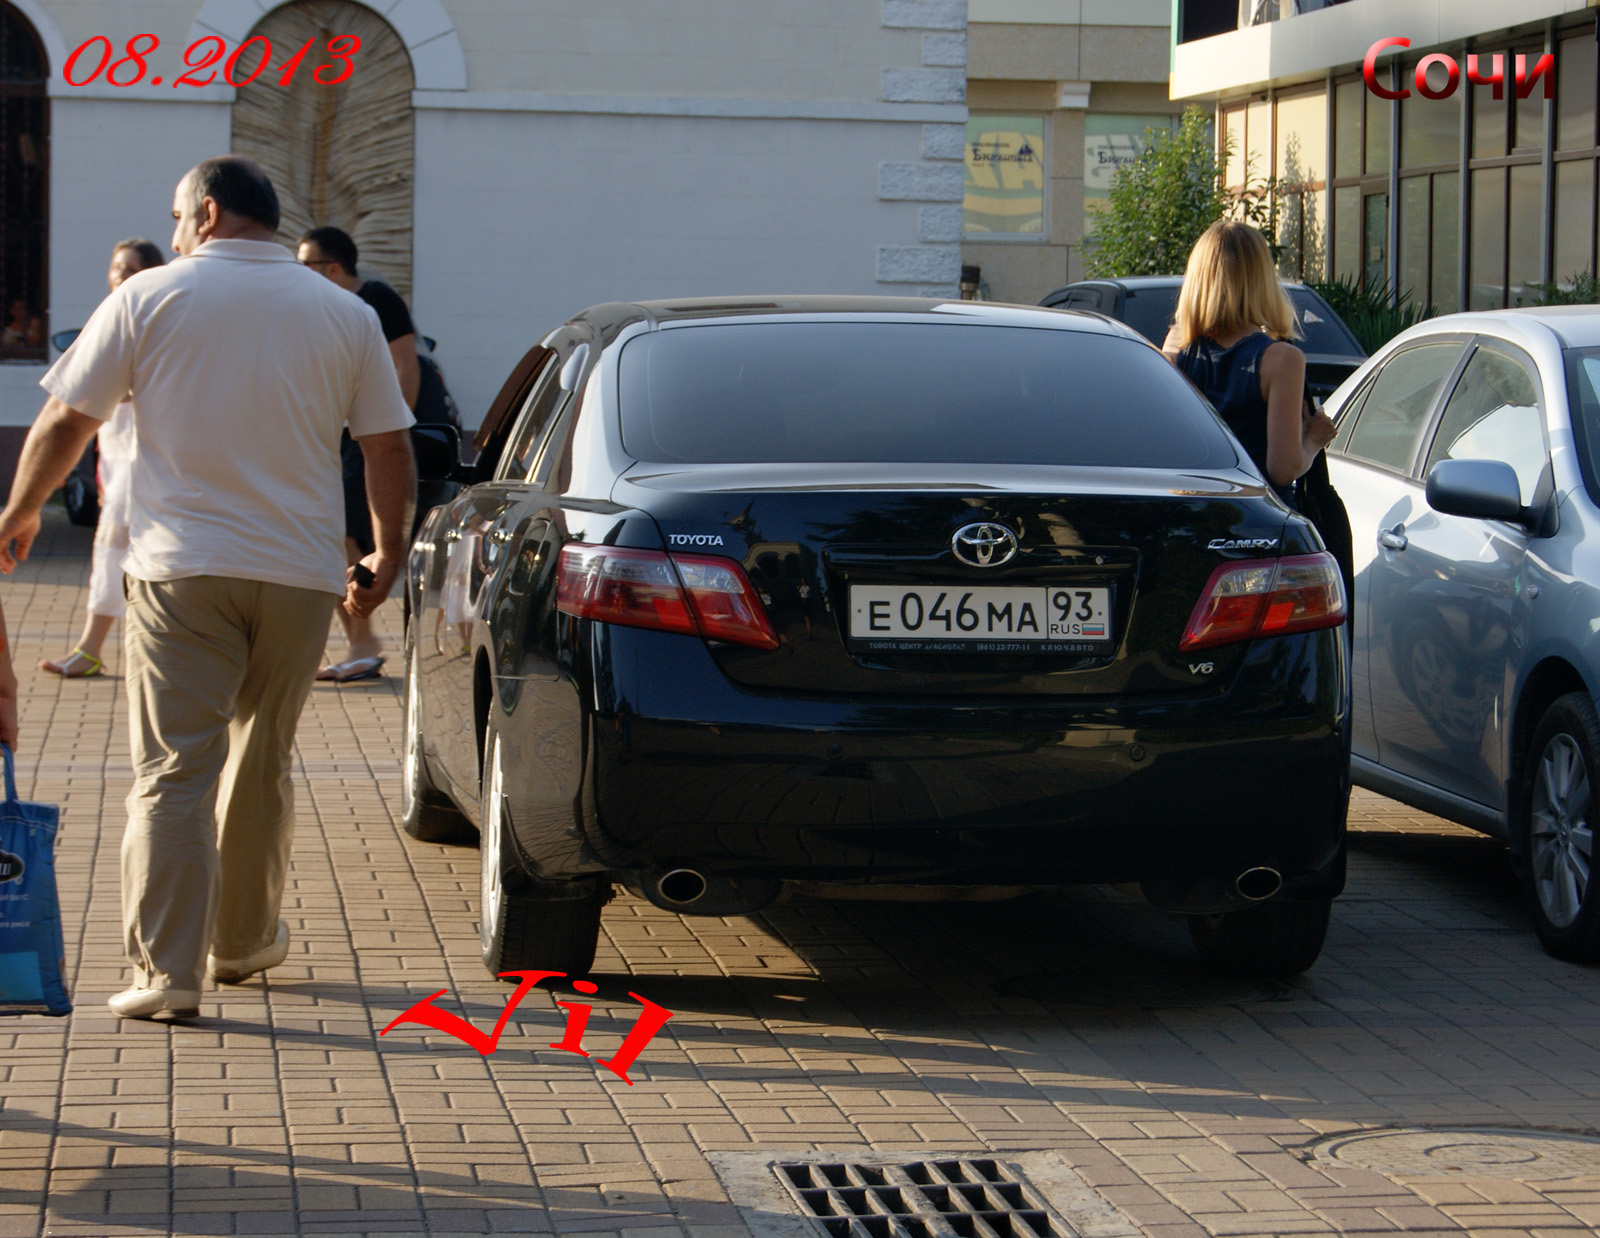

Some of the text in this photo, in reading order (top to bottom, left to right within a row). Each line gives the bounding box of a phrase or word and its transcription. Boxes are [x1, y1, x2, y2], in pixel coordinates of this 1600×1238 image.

[669, 534, 724, 546] TOYOTA
[1207, 538, 1278, 550] CAMRY
[1052, 591, 1093, 621] 93
[1050, 624, 1081, 635] RUS
[869, 642, 897, 650] ТОЙОТА
[899, 642, 922, 651] ЦЕНТР
[996, 643, 1030, 651] 22-777-11
[1189, 662, 1214, 675] V6
